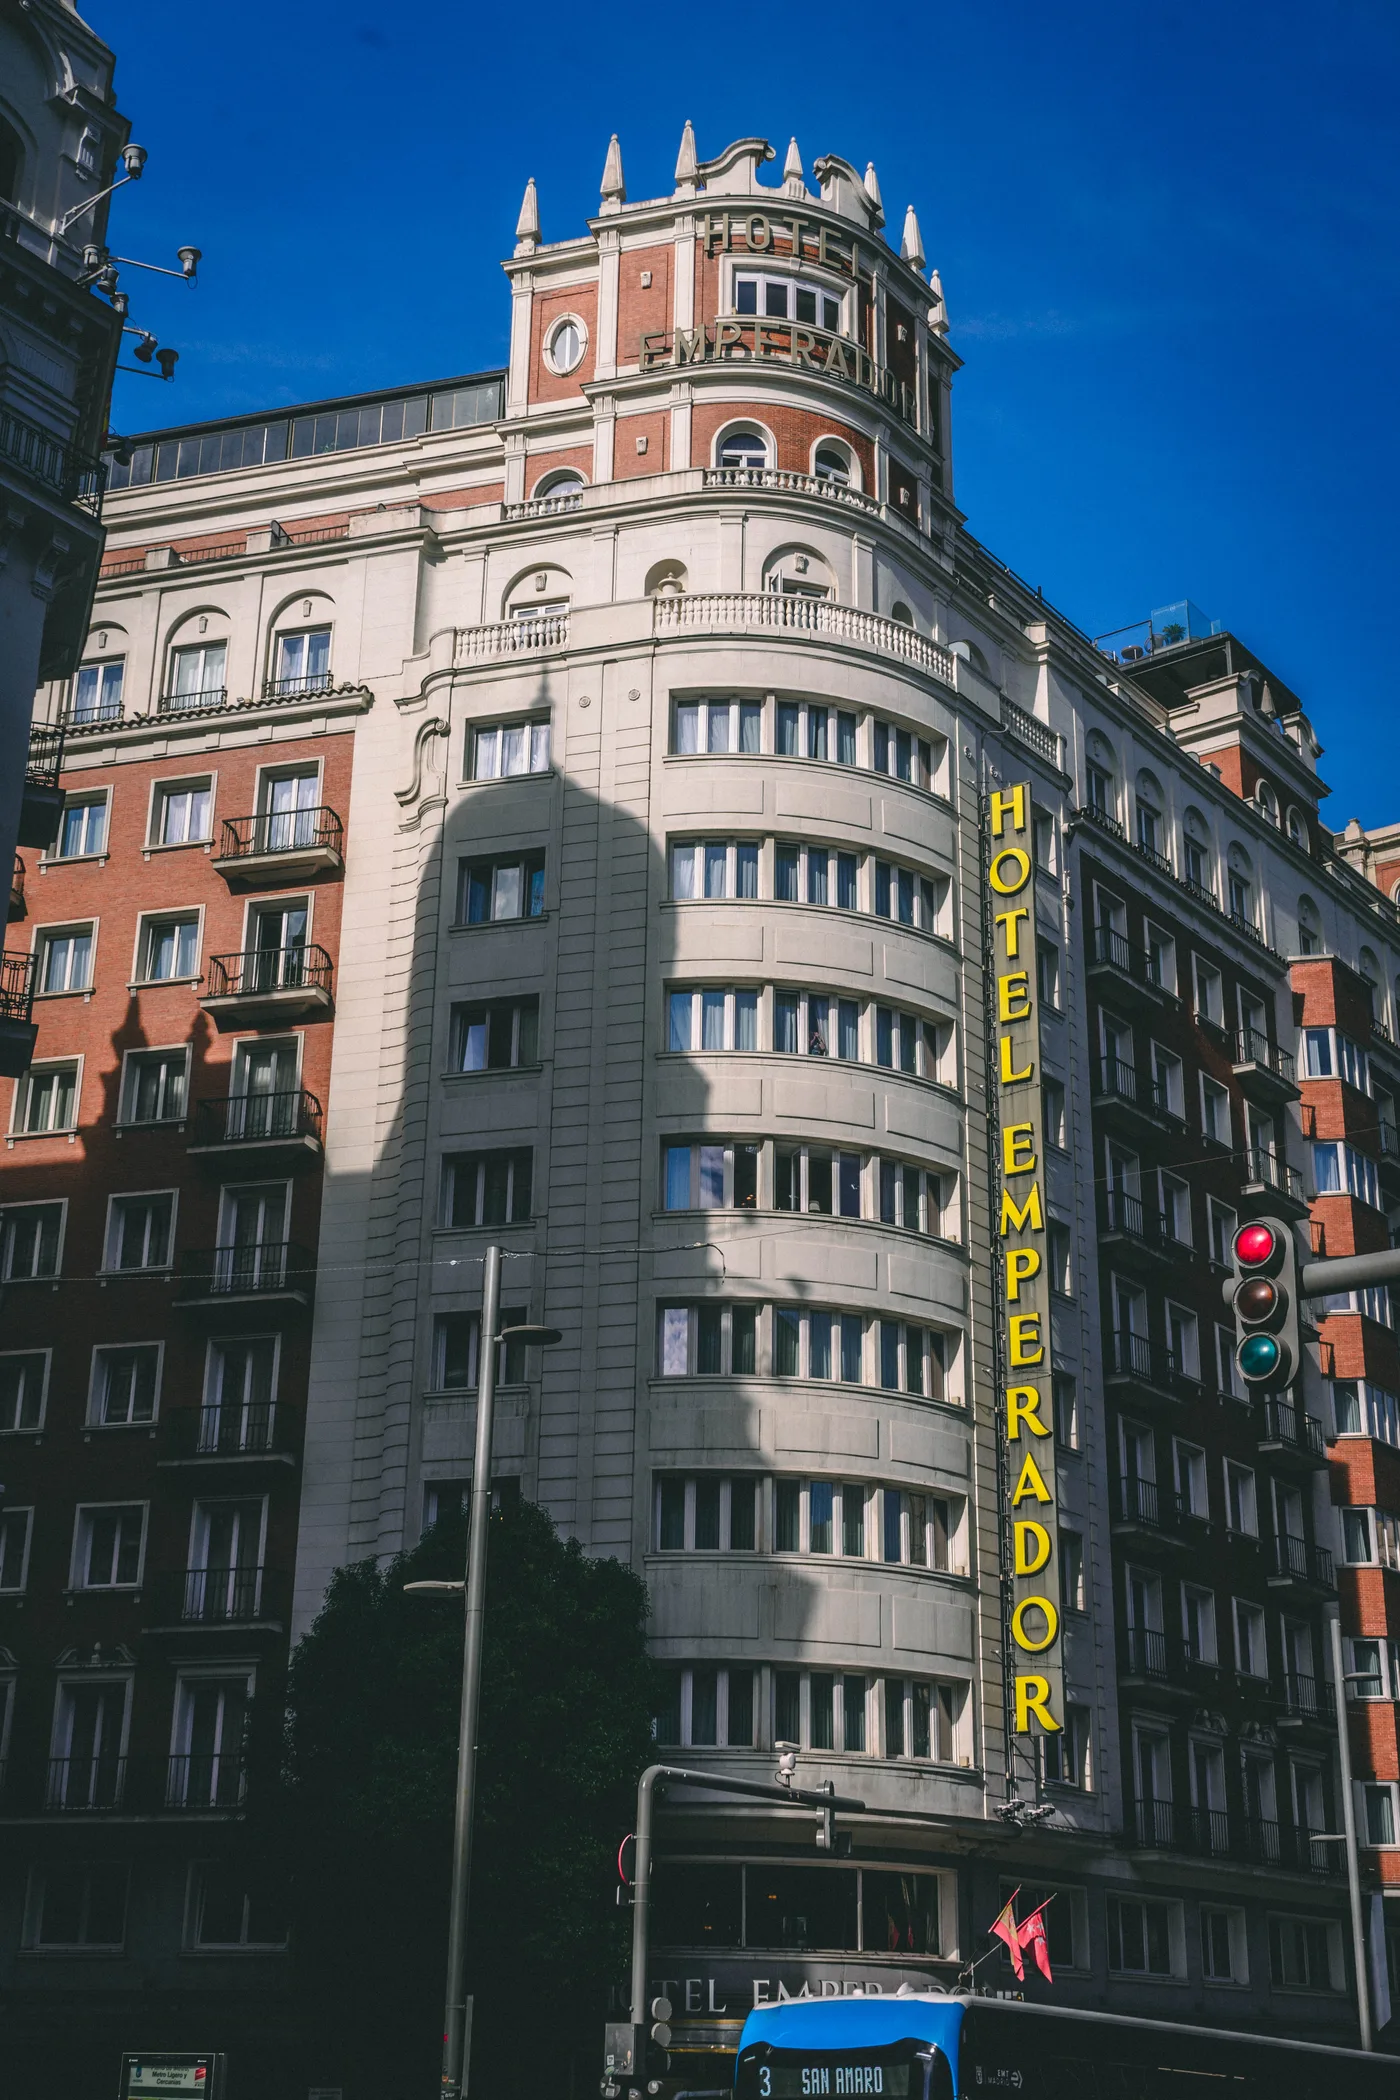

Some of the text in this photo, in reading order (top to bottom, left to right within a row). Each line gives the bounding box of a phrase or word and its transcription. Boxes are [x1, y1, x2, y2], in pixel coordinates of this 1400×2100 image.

[703, 212, 873, 287] HOTEL
[639, 320, 917, 427] EMPERADOR
[989, 785, 1065, 1736] HOTEL EMPERADOR
[759, 2066, 883, 2097] 3 SAN AMARO
